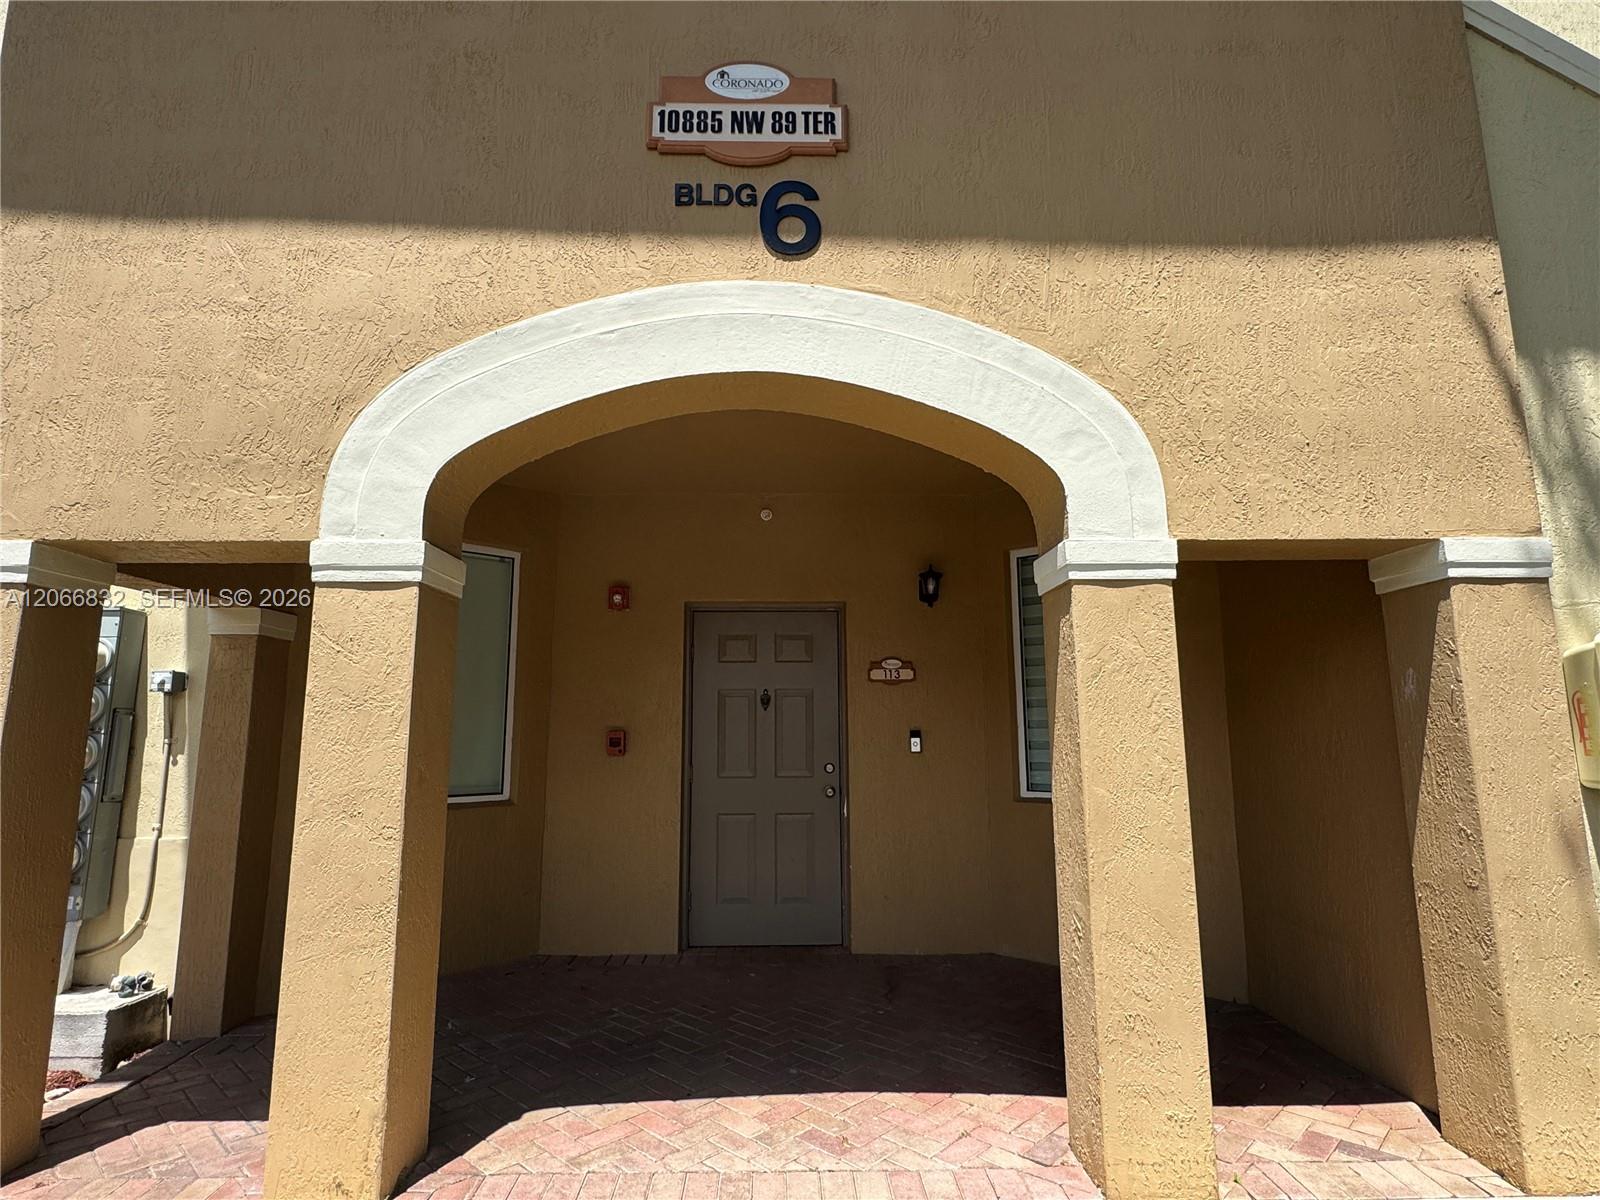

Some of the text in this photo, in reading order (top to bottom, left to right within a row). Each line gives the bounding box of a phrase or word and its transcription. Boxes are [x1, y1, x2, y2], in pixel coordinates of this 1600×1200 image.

[712, 79, 784, 89] CORONADO
[658, 109, 836, 135] 10885 NW 89 TER
[674, 180, 822, 256] BLDG 6
[883, 669, 900, 679] 113
